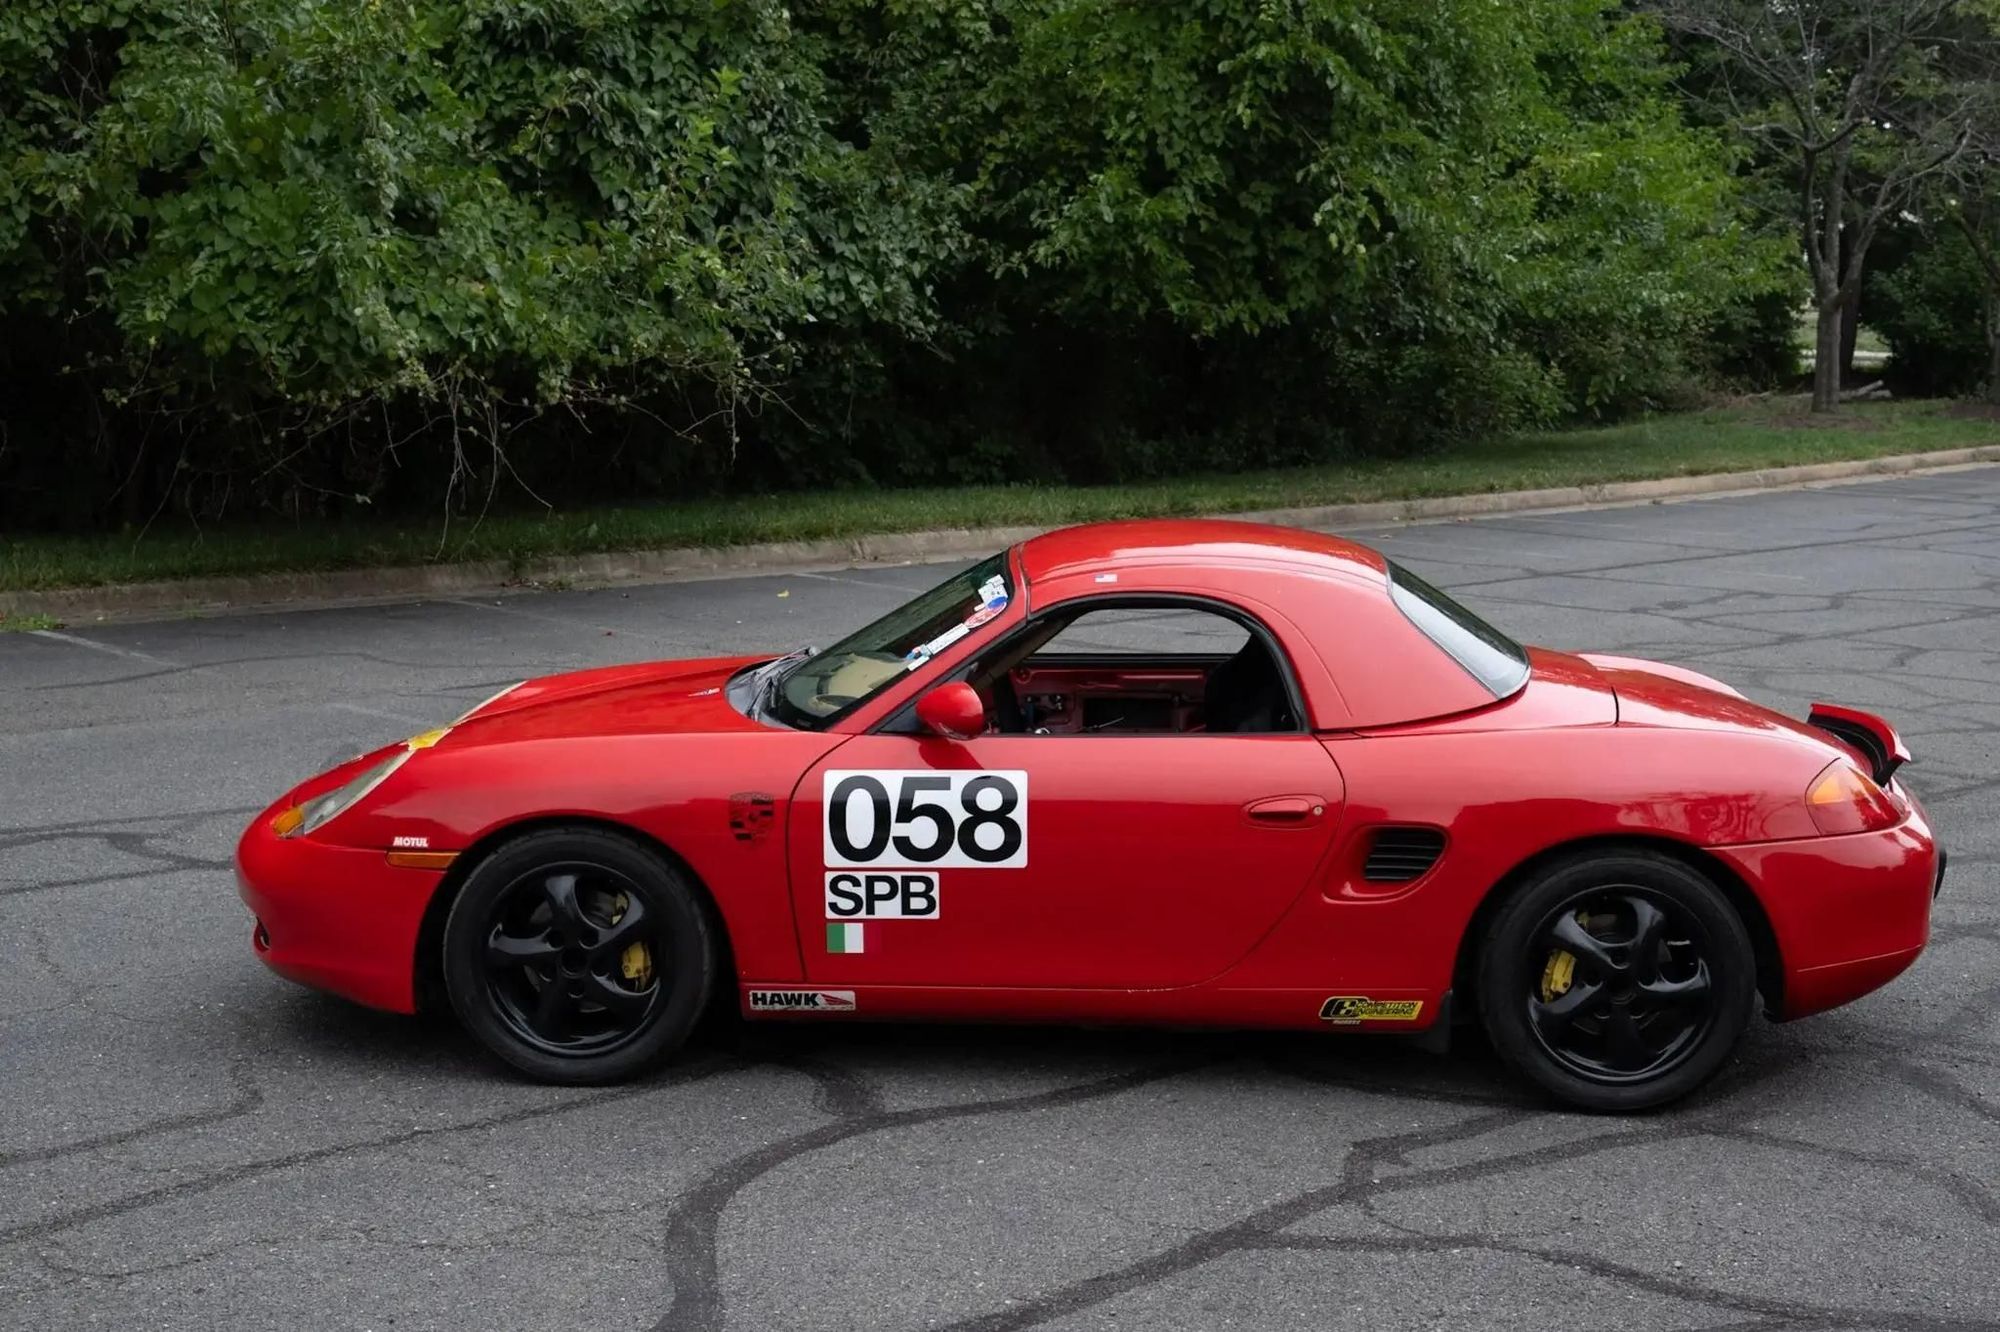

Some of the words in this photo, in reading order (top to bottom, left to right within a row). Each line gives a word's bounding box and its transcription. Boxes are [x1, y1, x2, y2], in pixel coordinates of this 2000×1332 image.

[829, 775, 1022, 863] 058
[393, 836, 429, 848] MOTUL
[828, 874, 937, 916] SPB
[751, 992, 820, 1007] HAWK
